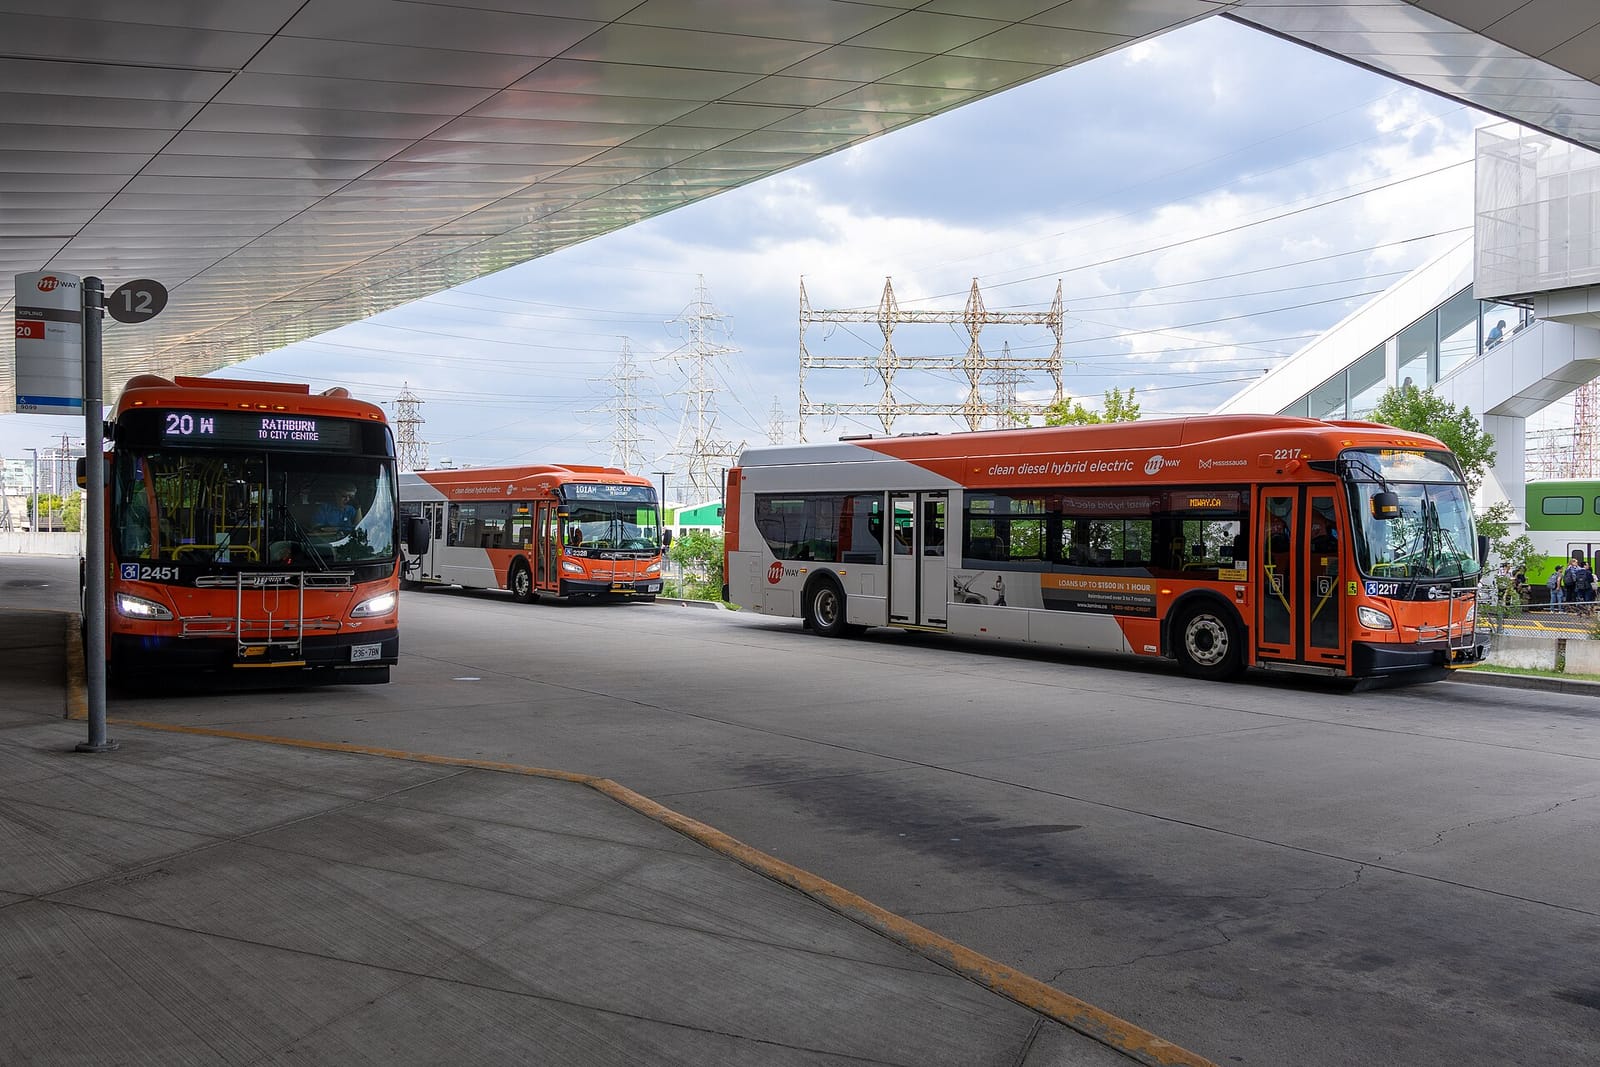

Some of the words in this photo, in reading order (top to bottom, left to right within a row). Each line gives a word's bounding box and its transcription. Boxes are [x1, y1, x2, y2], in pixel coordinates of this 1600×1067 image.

[120, 289, 153, 314] 12
[16, 326, 31, 337] 20
[166, 413, 194, 435] 20
[262, 418, 316, 432] RATHBURN
[258, 430, 268, 439] TO
[270, 430, 289, 440] CITY
[291, 431, 319, 441] CENTRE
[1274, 448, 1301, 460] 2217
[988, 463, 1015, 476] clean
[1017, 461, 1049, 475] diesel
[1051, 460, 1088, 476] hybrid
[1089, 459, 1135, 472] electric
[141, 566, 180, 581] 2451
[1058, 579, 1079, 587] LOANS
[1079, 580, 1088, 588] UP
[1131, 584, 1152, 592] HOUR
[1378, 583, 1399, 595] 2217
